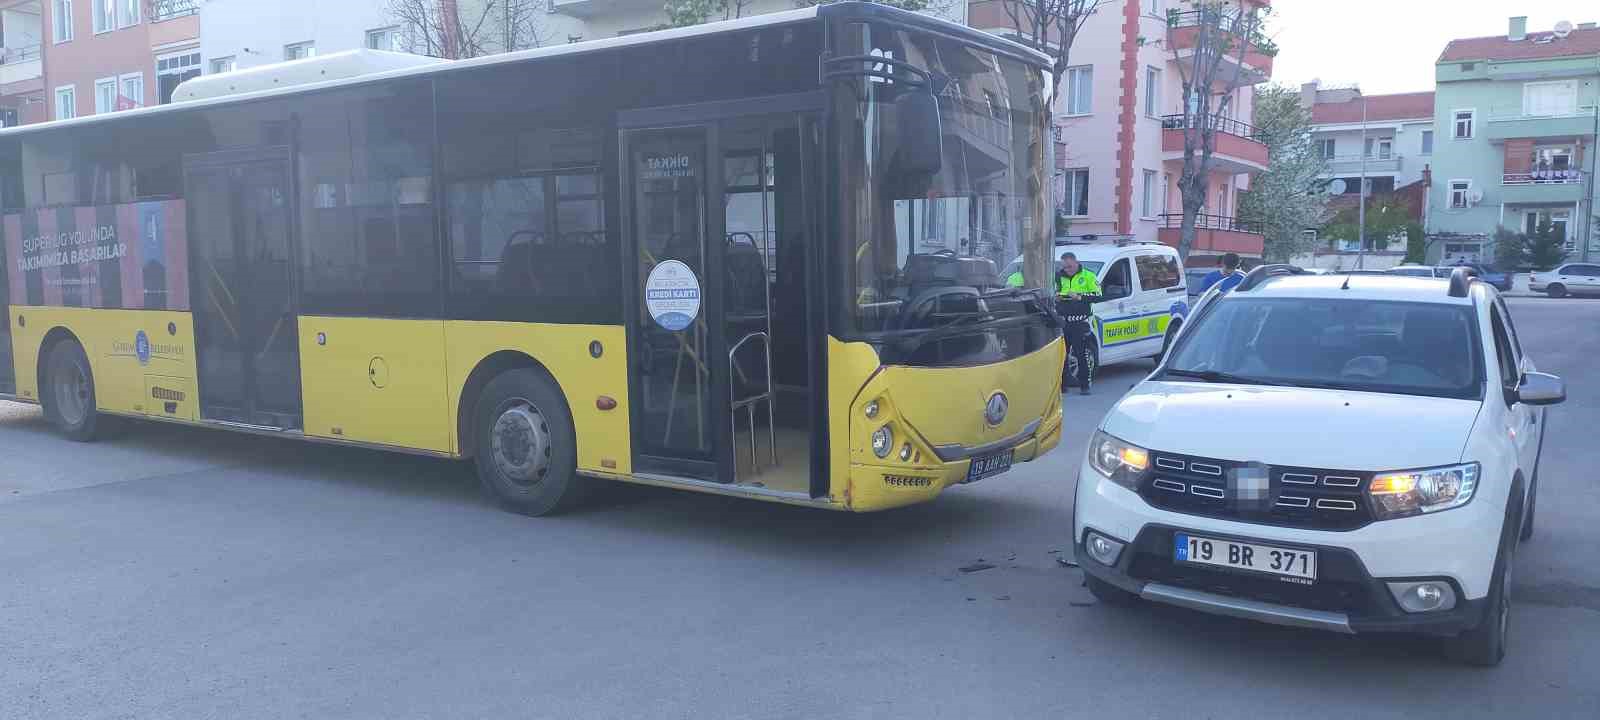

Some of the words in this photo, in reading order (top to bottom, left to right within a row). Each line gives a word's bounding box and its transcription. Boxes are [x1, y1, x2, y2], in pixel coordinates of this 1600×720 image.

[70, 242, 127, 266] BAŞARILAR
[1190, 539, 1213, 560] 19
[1228, 543, 1254, 567] BR
[1269, 550, 1308, 574] 371
